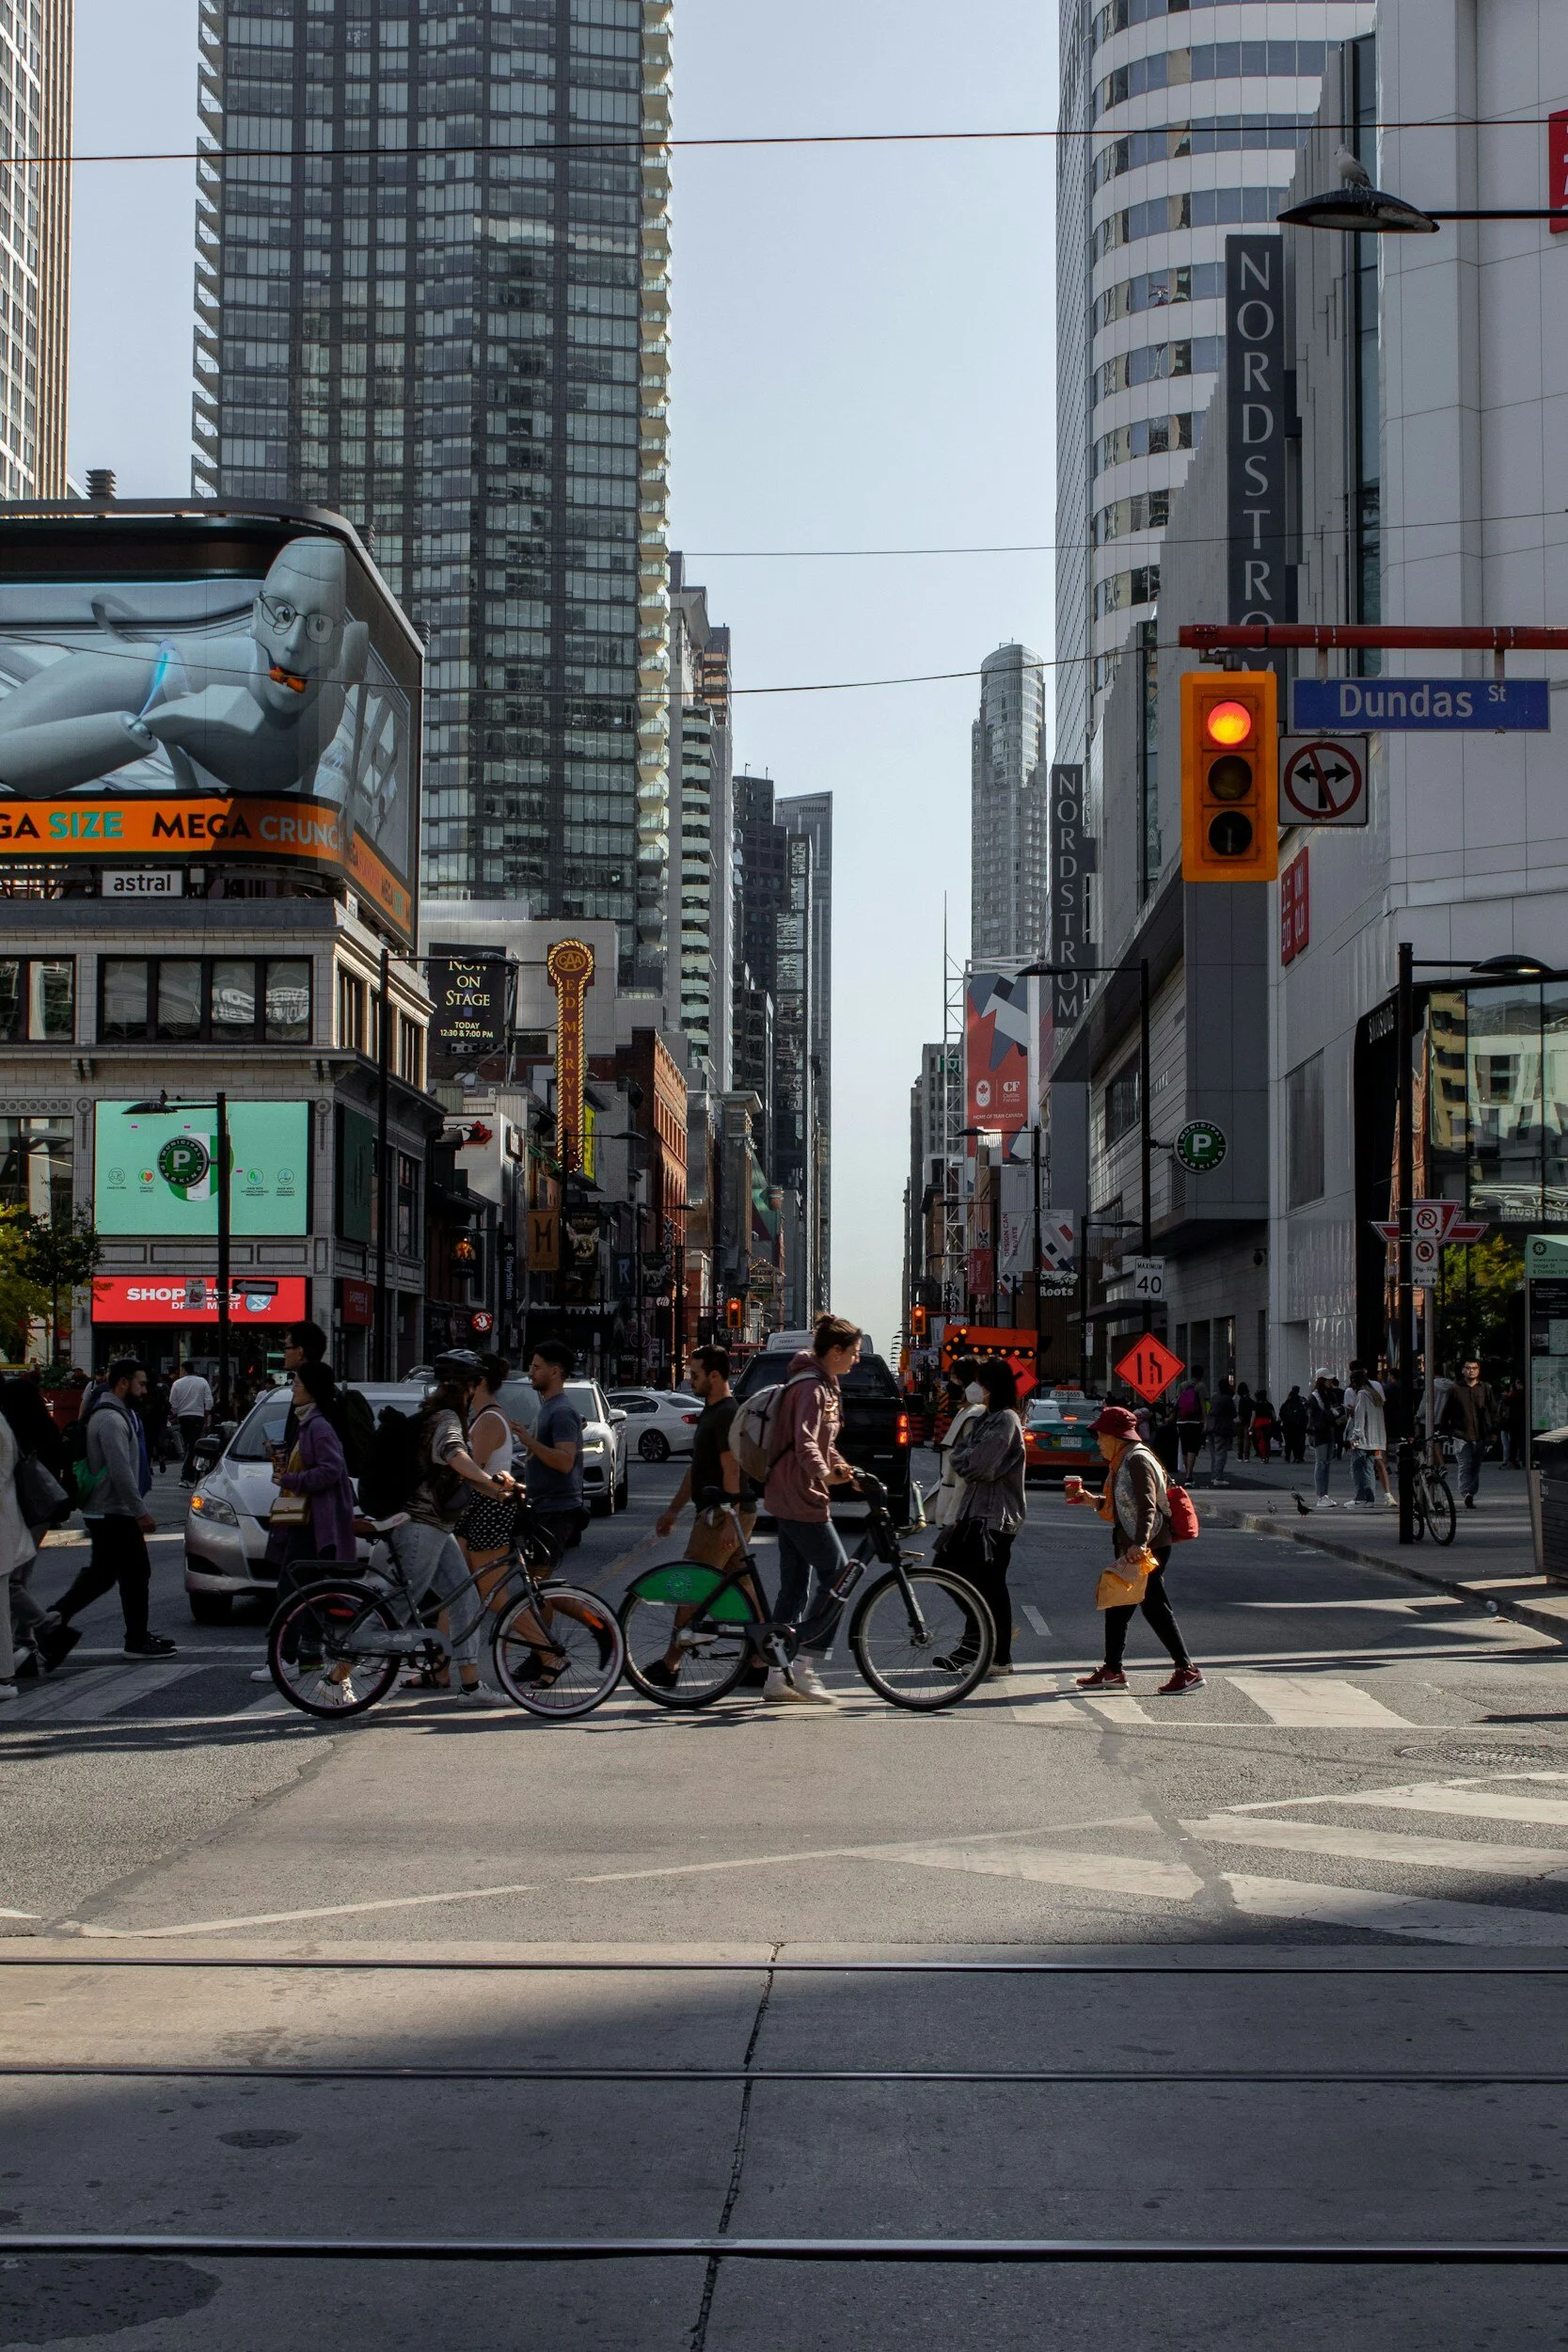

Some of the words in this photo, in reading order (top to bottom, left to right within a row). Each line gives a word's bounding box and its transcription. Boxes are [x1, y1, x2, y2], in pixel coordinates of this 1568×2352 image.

[1237, 251, 1275, 672] NORDSTRO
[1339, 684, 1474, 718] Dundas
[1488, 685, 1506, 702] St
[49, 812, 123, 839] SIZE
[151, 812, 252, 839] MEGA
[259, 816, 345, 850] CRUNC
[114, 874, 171, 892] astral
[1057, 772, 1079, 1018] NORDSTROM
[558, 953, 583, 968] CAA
[456, 976, 482, 988] ON
[446, 990, 491, 1006] STAGE
[565, 978, 577, 1009] ED
[1180, 1123, 1223, 1141] MUNICIPAL
[162, 1140, 202, 1156] MUNICIPAL
[1193, 1134, 1212, 1153] P
[173, 1150, 191, 1168] P
[1179, 1149, 1224, 1168] PARKING
[161, 1165, 202, 1183] PARKING
[504, 1256, 515, 1300] PlayStation
[1137, 1276, 1162, 1294] 40
